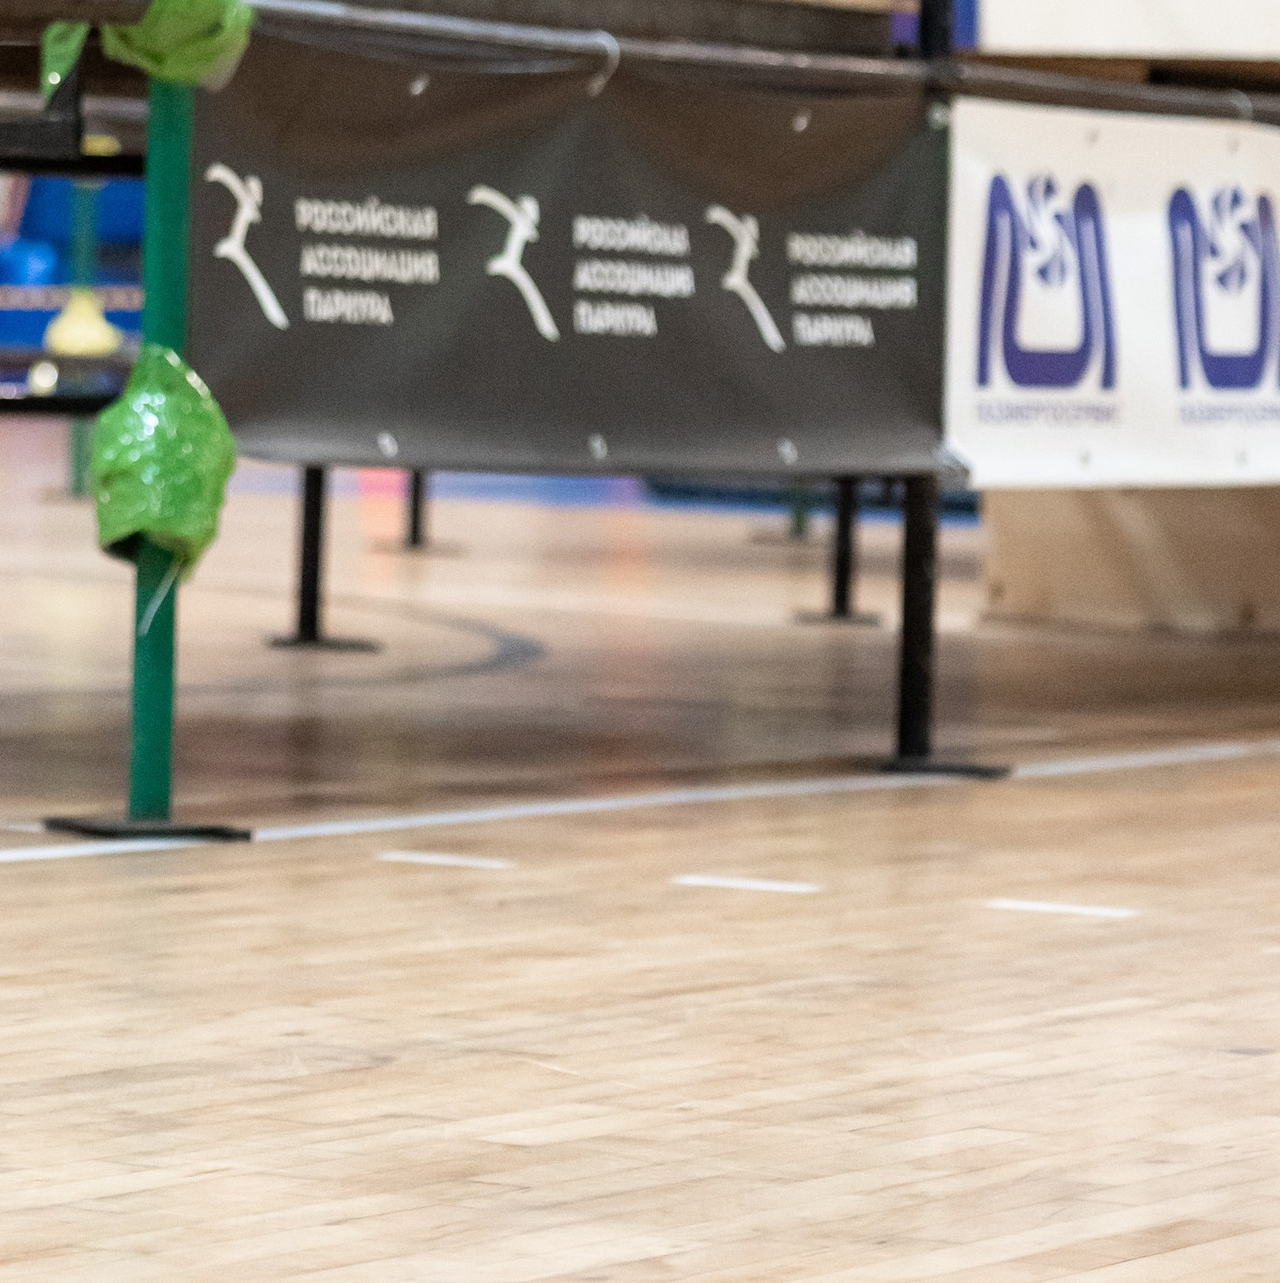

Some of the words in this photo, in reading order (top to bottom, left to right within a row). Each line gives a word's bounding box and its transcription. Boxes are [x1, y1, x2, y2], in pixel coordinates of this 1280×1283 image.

[295, 195, 438, 240] РОССИЙСКАЯ
[299, 244, 440, 284] АССОЦИАЦИЯ
[303, 286, 394, 326] ПАРКУРА
